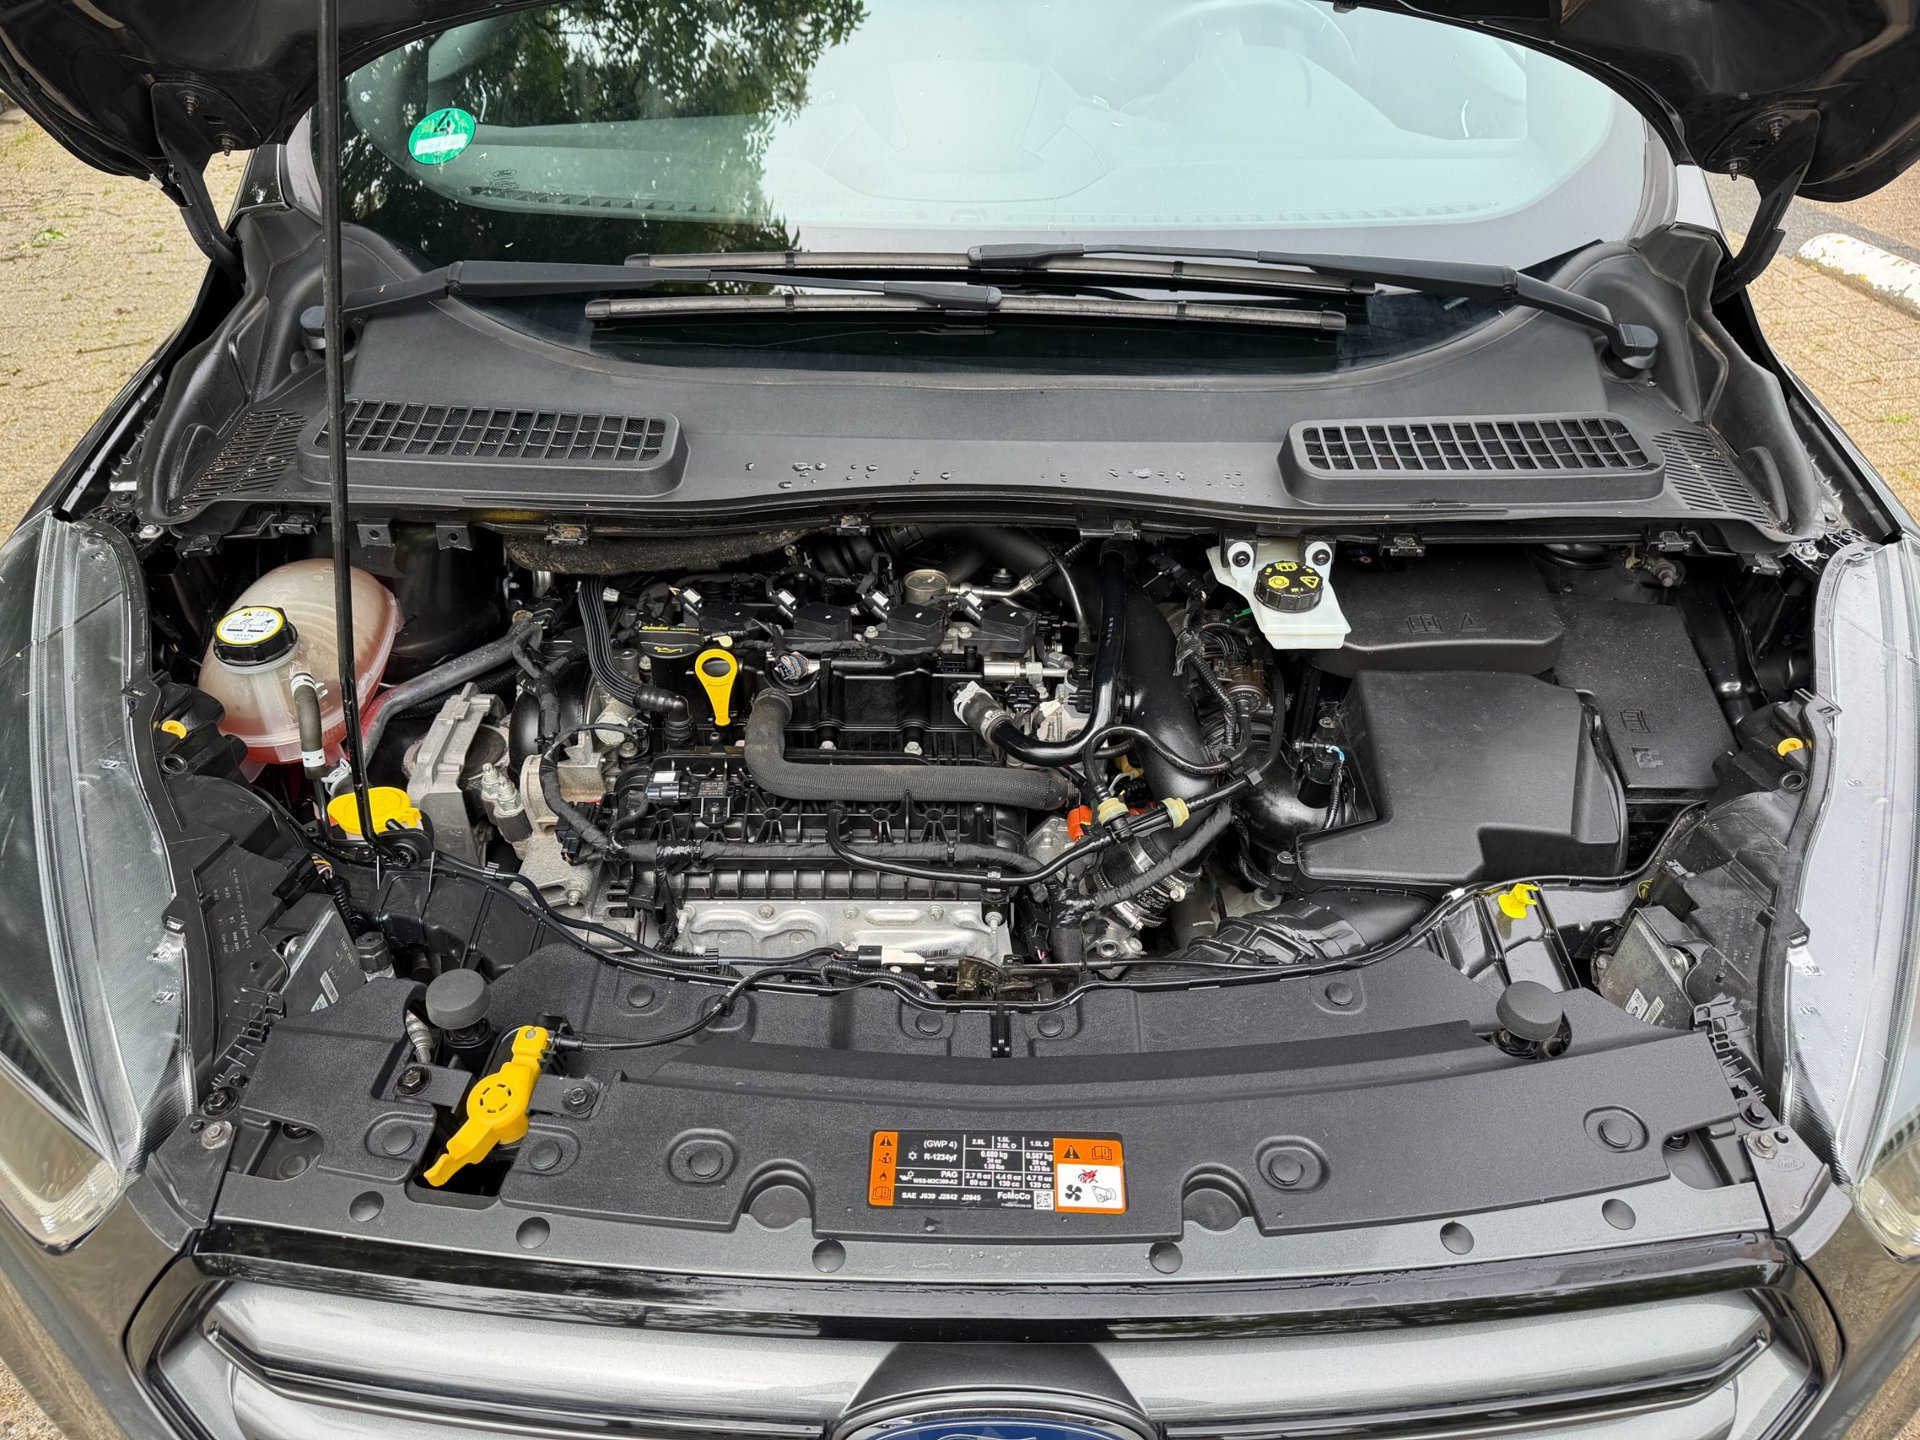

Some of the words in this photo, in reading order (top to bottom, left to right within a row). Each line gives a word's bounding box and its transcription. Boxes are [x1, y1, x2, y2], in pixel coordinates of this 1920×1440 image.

[923, 1140, 948, 1149] (GWP
[948, 1140, 958, 1150] 4)
[923, 1153, 958, 1162] R-1234yf
[998, 1151, 1008, 1160] kg
[1043, 1153, 1053, 1161] kg
[940, 1170, 958, 1178] PAG
[997, 1191, 1031, 1200] FoMoCo
